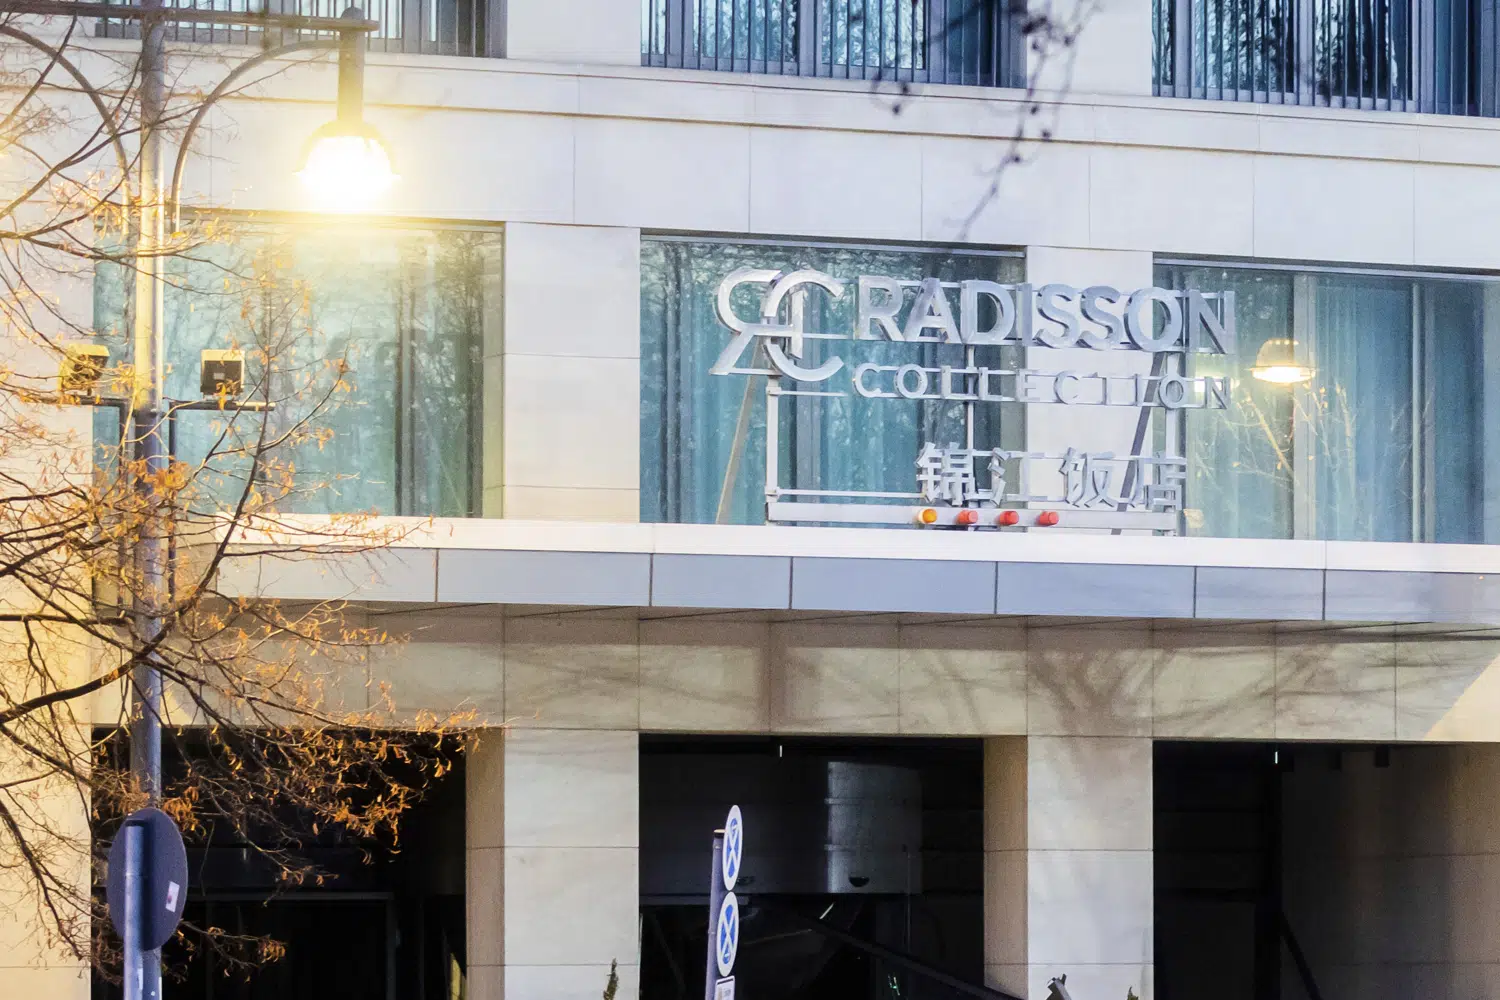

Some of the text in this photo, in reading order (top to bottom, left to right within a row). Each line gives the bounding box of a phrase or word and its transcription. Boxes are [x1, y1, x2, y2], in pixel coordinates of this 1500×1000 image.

[857, 275, 1236, 354] RADISSON
[852, 362, 1231, 410] COLLECTION
[915, 442, 1186, 510] 锦江饭店
